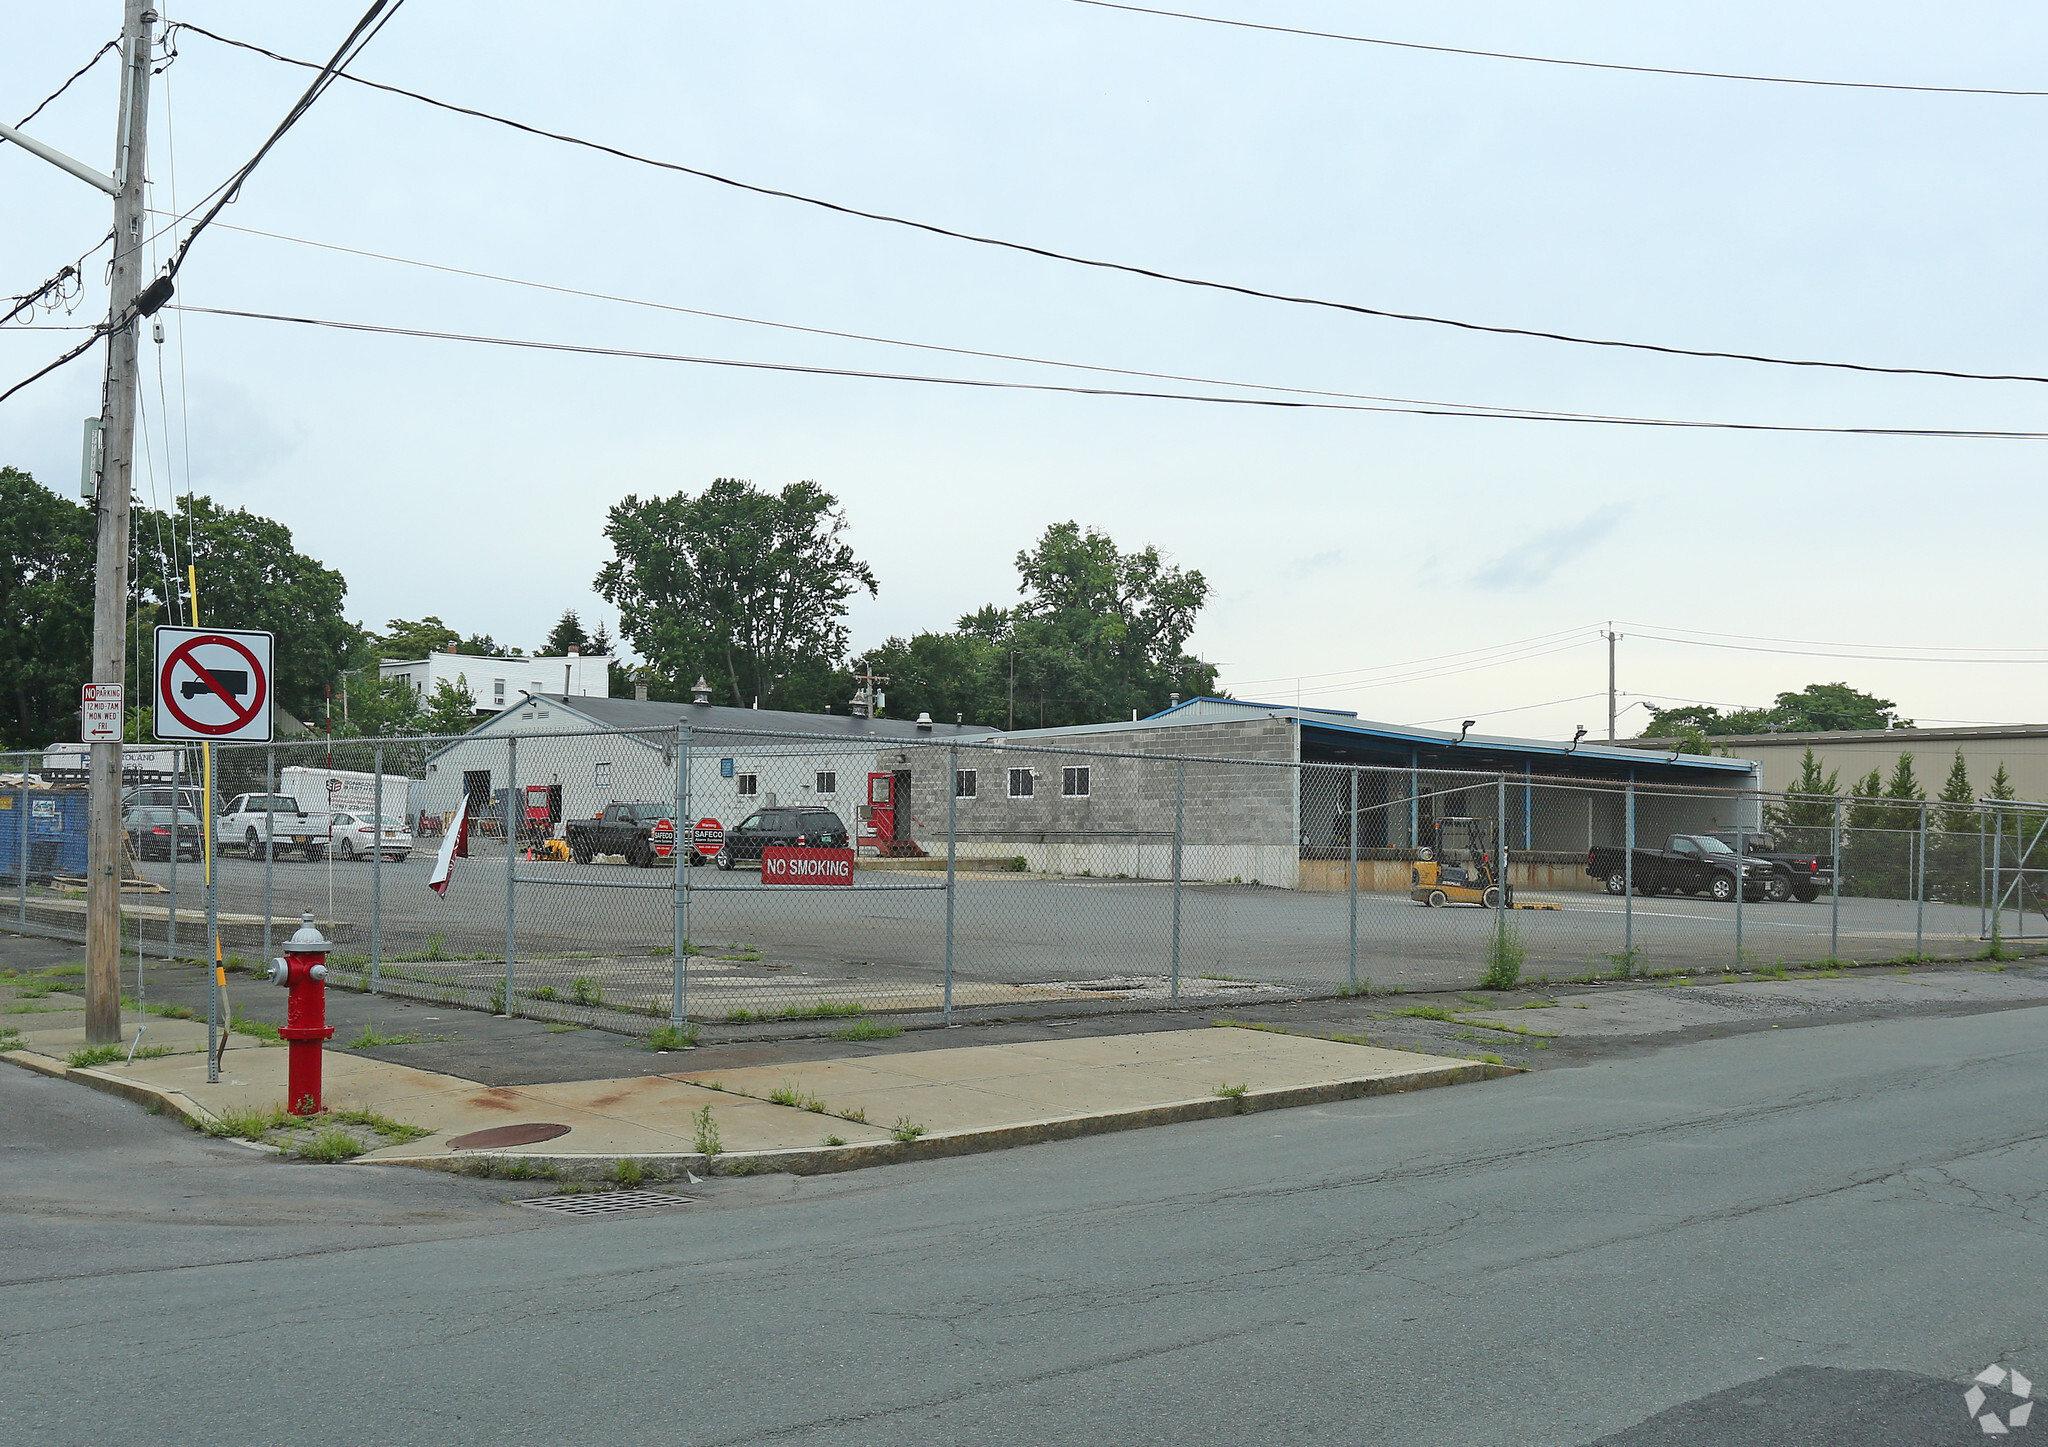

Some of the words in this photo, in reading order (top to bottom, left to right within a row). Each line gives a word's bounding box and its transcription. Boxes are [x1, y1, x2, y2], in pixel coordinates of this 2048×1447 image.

[85, 688, 96, 699] NO
[96, 689, 120, 698] PARKING
[88, 712, 102, 720] MON
[104, 712, 117, 720] WED
[98, 722, 108, 730] FRI
[694, 830, 723, 839] SAFECO
[767, 858, 786, 875] NO
[789, 859, 849, 876] SMOKING
